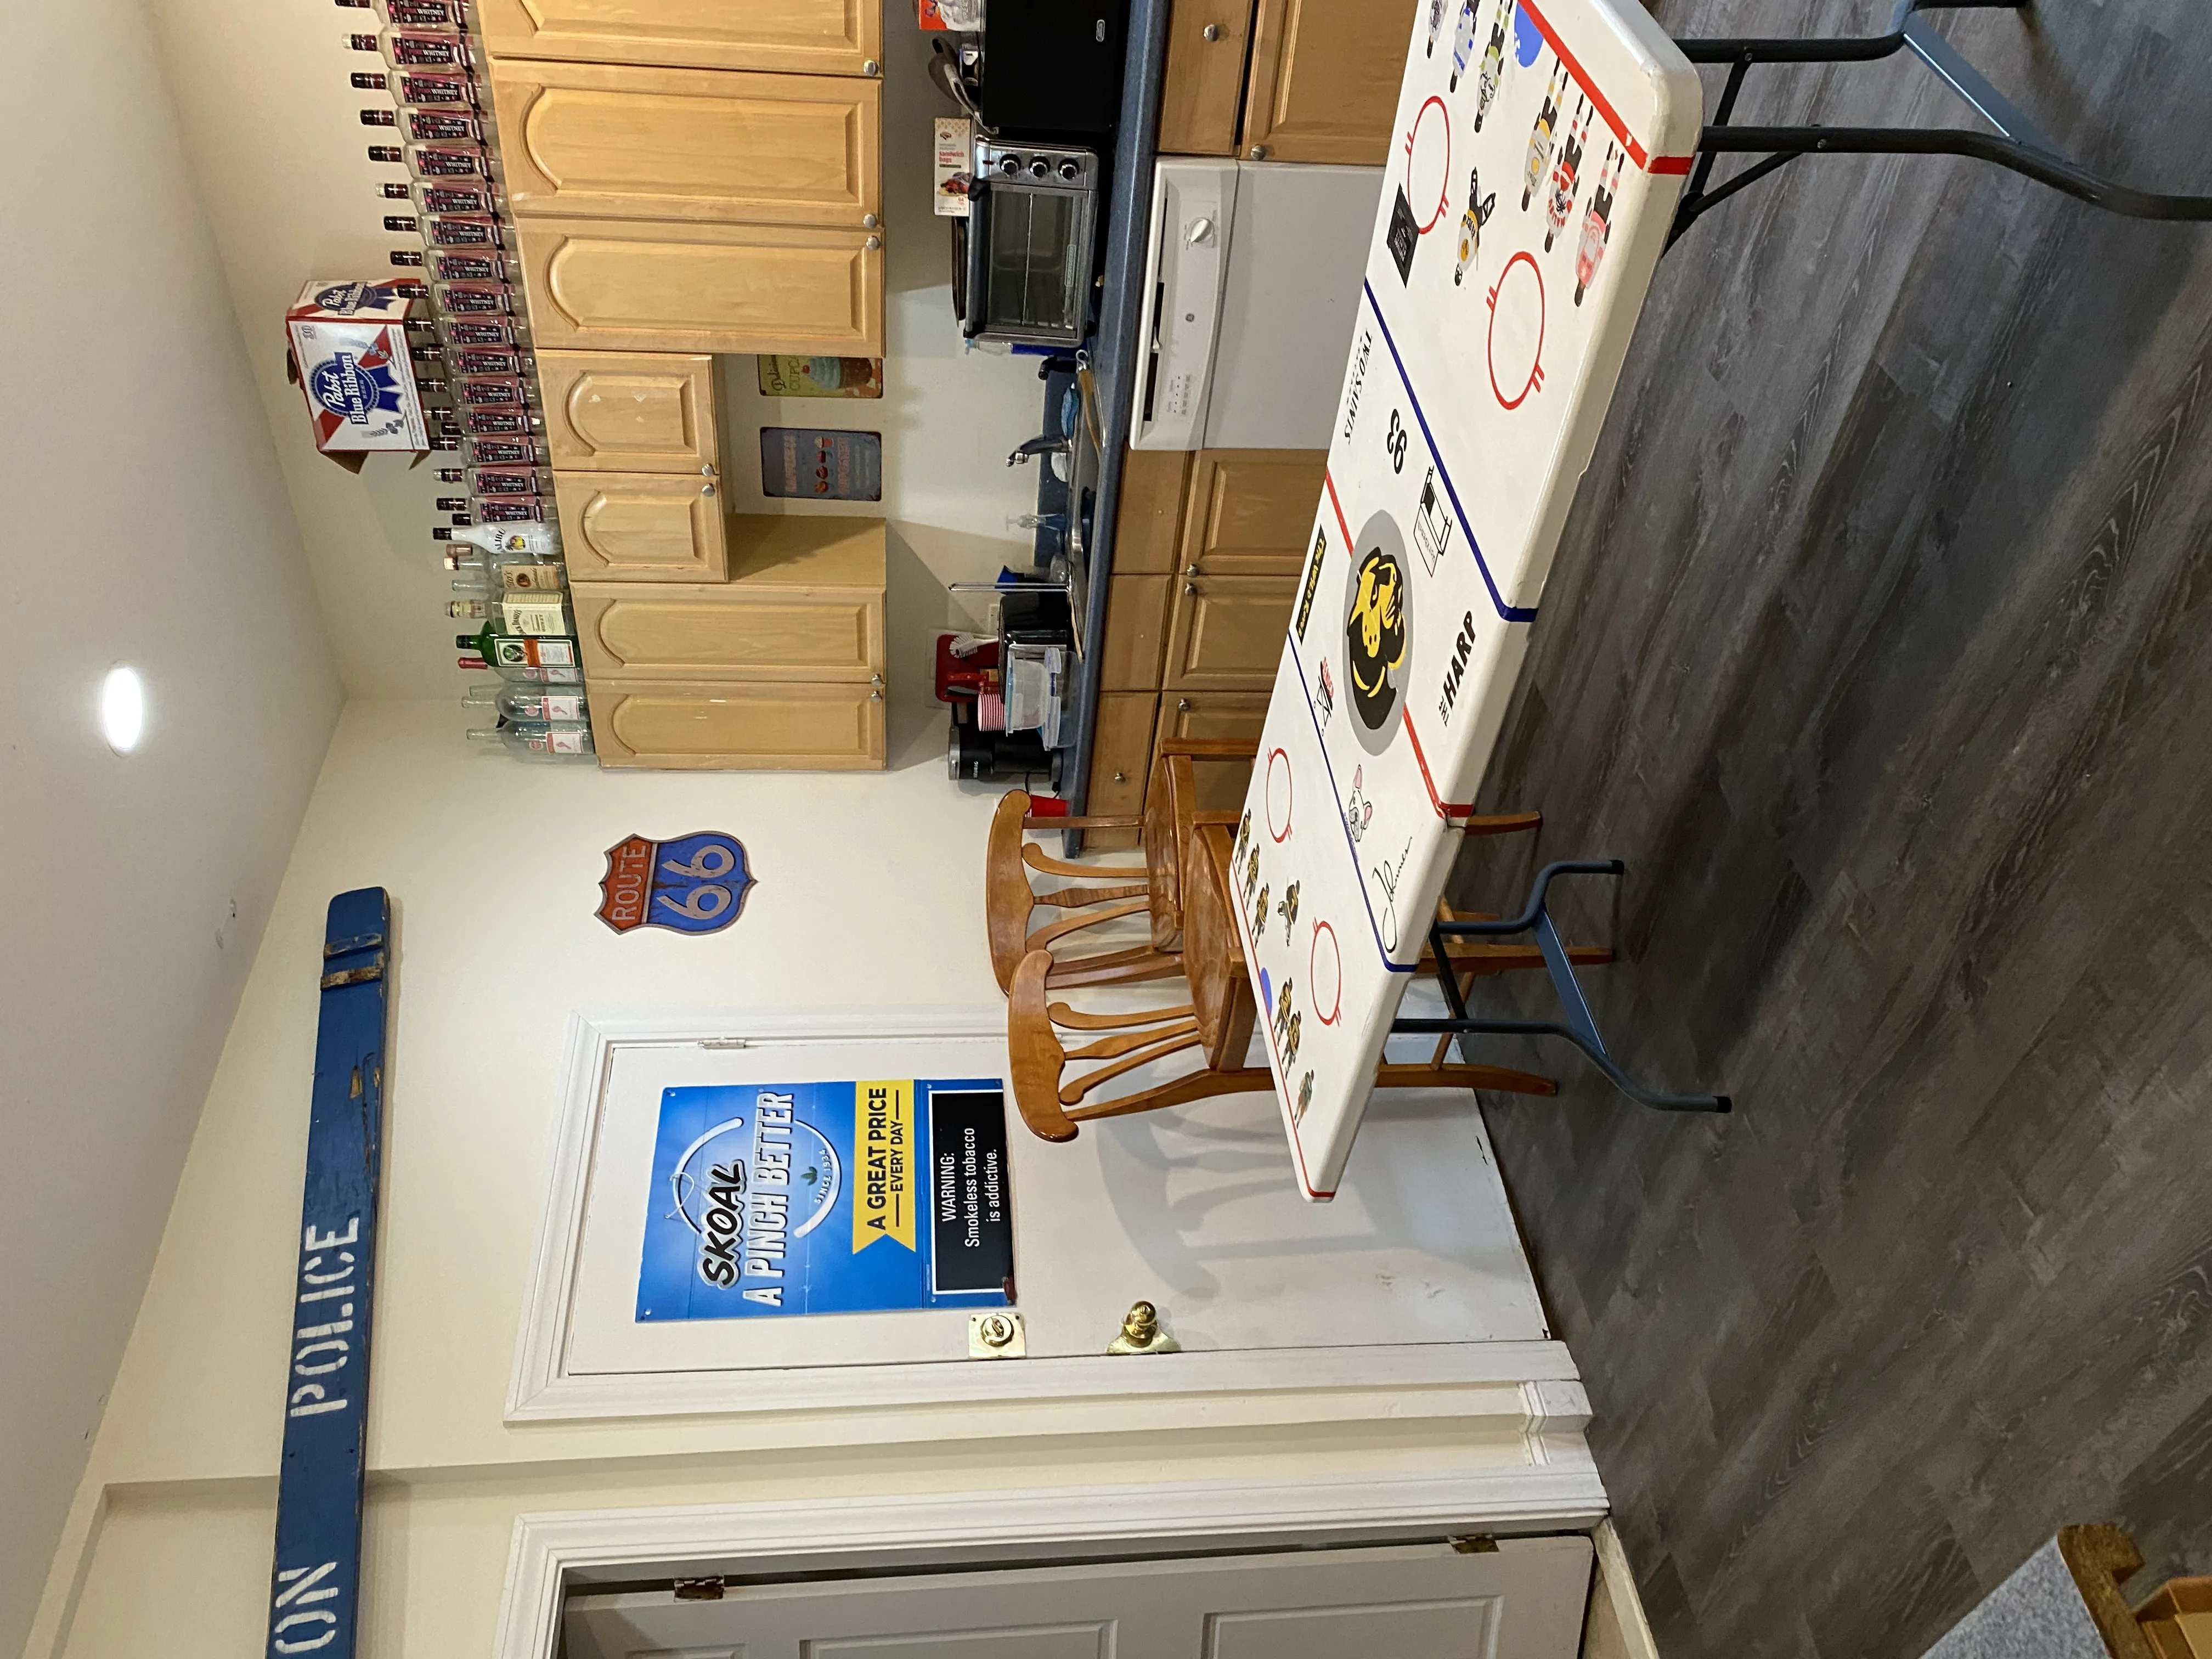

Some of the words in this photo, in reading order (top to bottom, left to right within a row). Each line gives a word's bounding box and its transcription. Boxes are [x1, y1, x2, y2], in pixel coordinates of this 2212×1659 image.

[321, 289, 347, 307] Pabst
[341, 354, 360, 397] Ribbon
[1359, 328, 1373, 376] TWO
[320, 370, 347, 408] Pabst
[349, 397, 368, 424] Blue
[1344, 375, 1363, 445] SAINTS
[1386, 408, 1407, 475] 93
[1443, 610, 1476, 710] HARP
[1438, 695, 1451, 727] THE
[611, 845, 646, 921] ROUTE
[656, 844, 735, 919] 66
[755, 1093, 794, 1186] BETTER
[867, 1088, 887, 1141] PRICE
[890, 1120, 903, 1146] DAY
[818, 1148, 831, 1172] 1934
[867, 1146, 887, 1210] GREAT
[891, 1149, 904, 1192] EVERY
[963, 1128, 977, 1176] tobacco
[984, 1148, 1000, 1208] addictive.
[813, 1175, 832, 1205] SINCE
[940, 1152, 956, 1222] WARNING:
[963, 1179, 980, 1248] Smokeless
[699, 1161, 743, 1288] SKOAL
[744, 1194, 789, 1278] PINCH
[867, 1215, 886, 1231] A
[986, 1210, 1001, 1222] is
[290, 1217, 359, 1418] POLICE
[743, 1287, 783, 1306] A
[274, 1561, 338, 1654] ON
